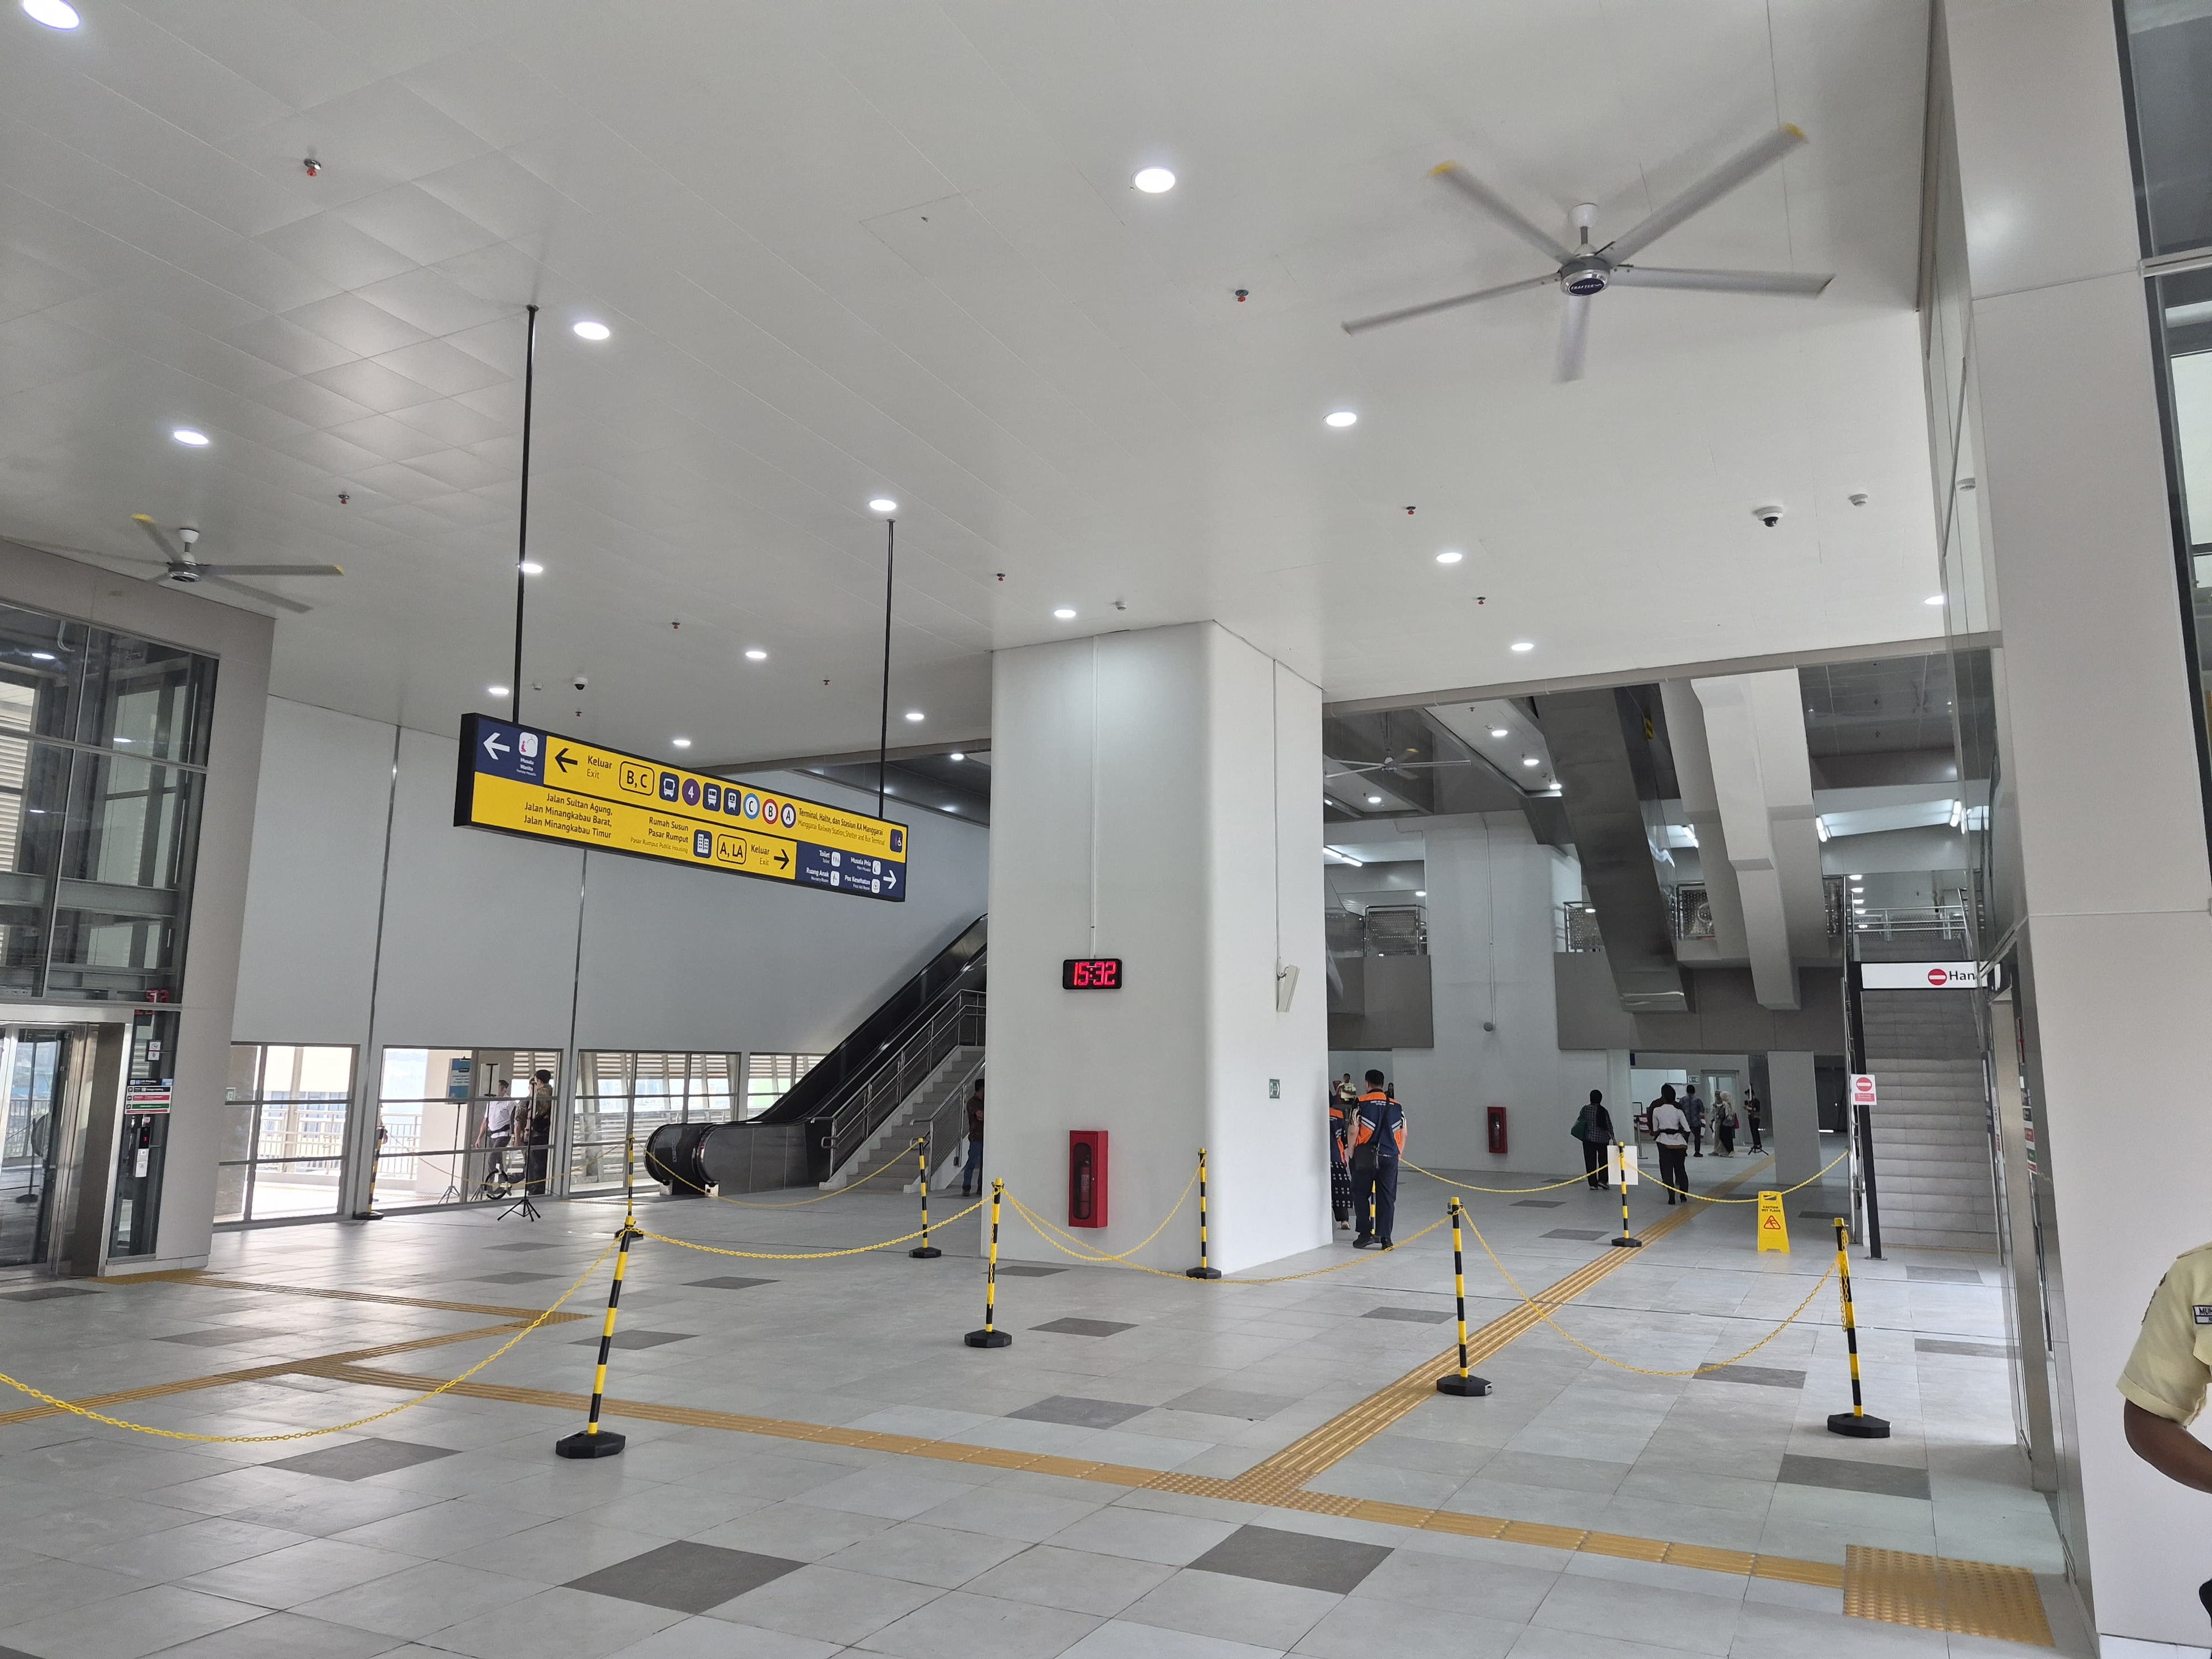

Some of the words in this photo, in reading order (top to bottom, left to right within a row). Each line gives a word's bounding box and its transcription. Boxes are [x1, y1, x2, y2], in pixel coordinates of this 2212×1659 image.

[588, 755, 612, 769] Keluar
[587, 768, 600, 779] Exit
[688, 786, 694, 798] 4
[547, 793, 565, 804] Jalan
[566, 797, 588, 809] Sultan
[590, 802, 612, 816] Agung,
[749, 801, 753, 812] C
[525, 802, 543, 813] Jalan
[546, 806, 591, 822] Minangkabau
[593, 816, 612, 827] Barat,
[768, 806, 773, 817] B
[786, 810, 791, 821] A
[524, 815, 542, 825] Jalan
[544, 819, 590, 834] Minangkabau
[592, 828, 611, 839] Timur
[649, 816, 669, 828] Rumah
[672, 821, 688, 831] Susun
[798, 808, 819, 821] Terminal,
[819, 813, 832, 824] Halte,
[832, 817, 840, 825] dan
[841, 819, 856, 828] Stasiun
[857, 823, 862, 831] KA
[863, 824, 884, 836] Manggarai
[649, 828, 664, 838] Pasar
[666, 832, 688, 843] Rumput
[798, 819, 817, 830] Manggarai
[818, 824, 832, 835] Railway
[846, 831, 857, 839] Shelter
[872, 836, 885, 846] Terminal
[642, 839, 658, 848] Rumput
[672, 844, 688, 854] Housing
[732, 844, 743, 858] LA
[751, 844, 770, 855] Keluar
[819, 850, 830, 858] Toilet
[759, 857, 770, 866] Exit
[850, 857, 863, 865] Musala
[806, 867, 819, 876] Ruang
[852, 876, 870, 885] Kesehatan
[1074, 961, 1116, 986] 15:32
